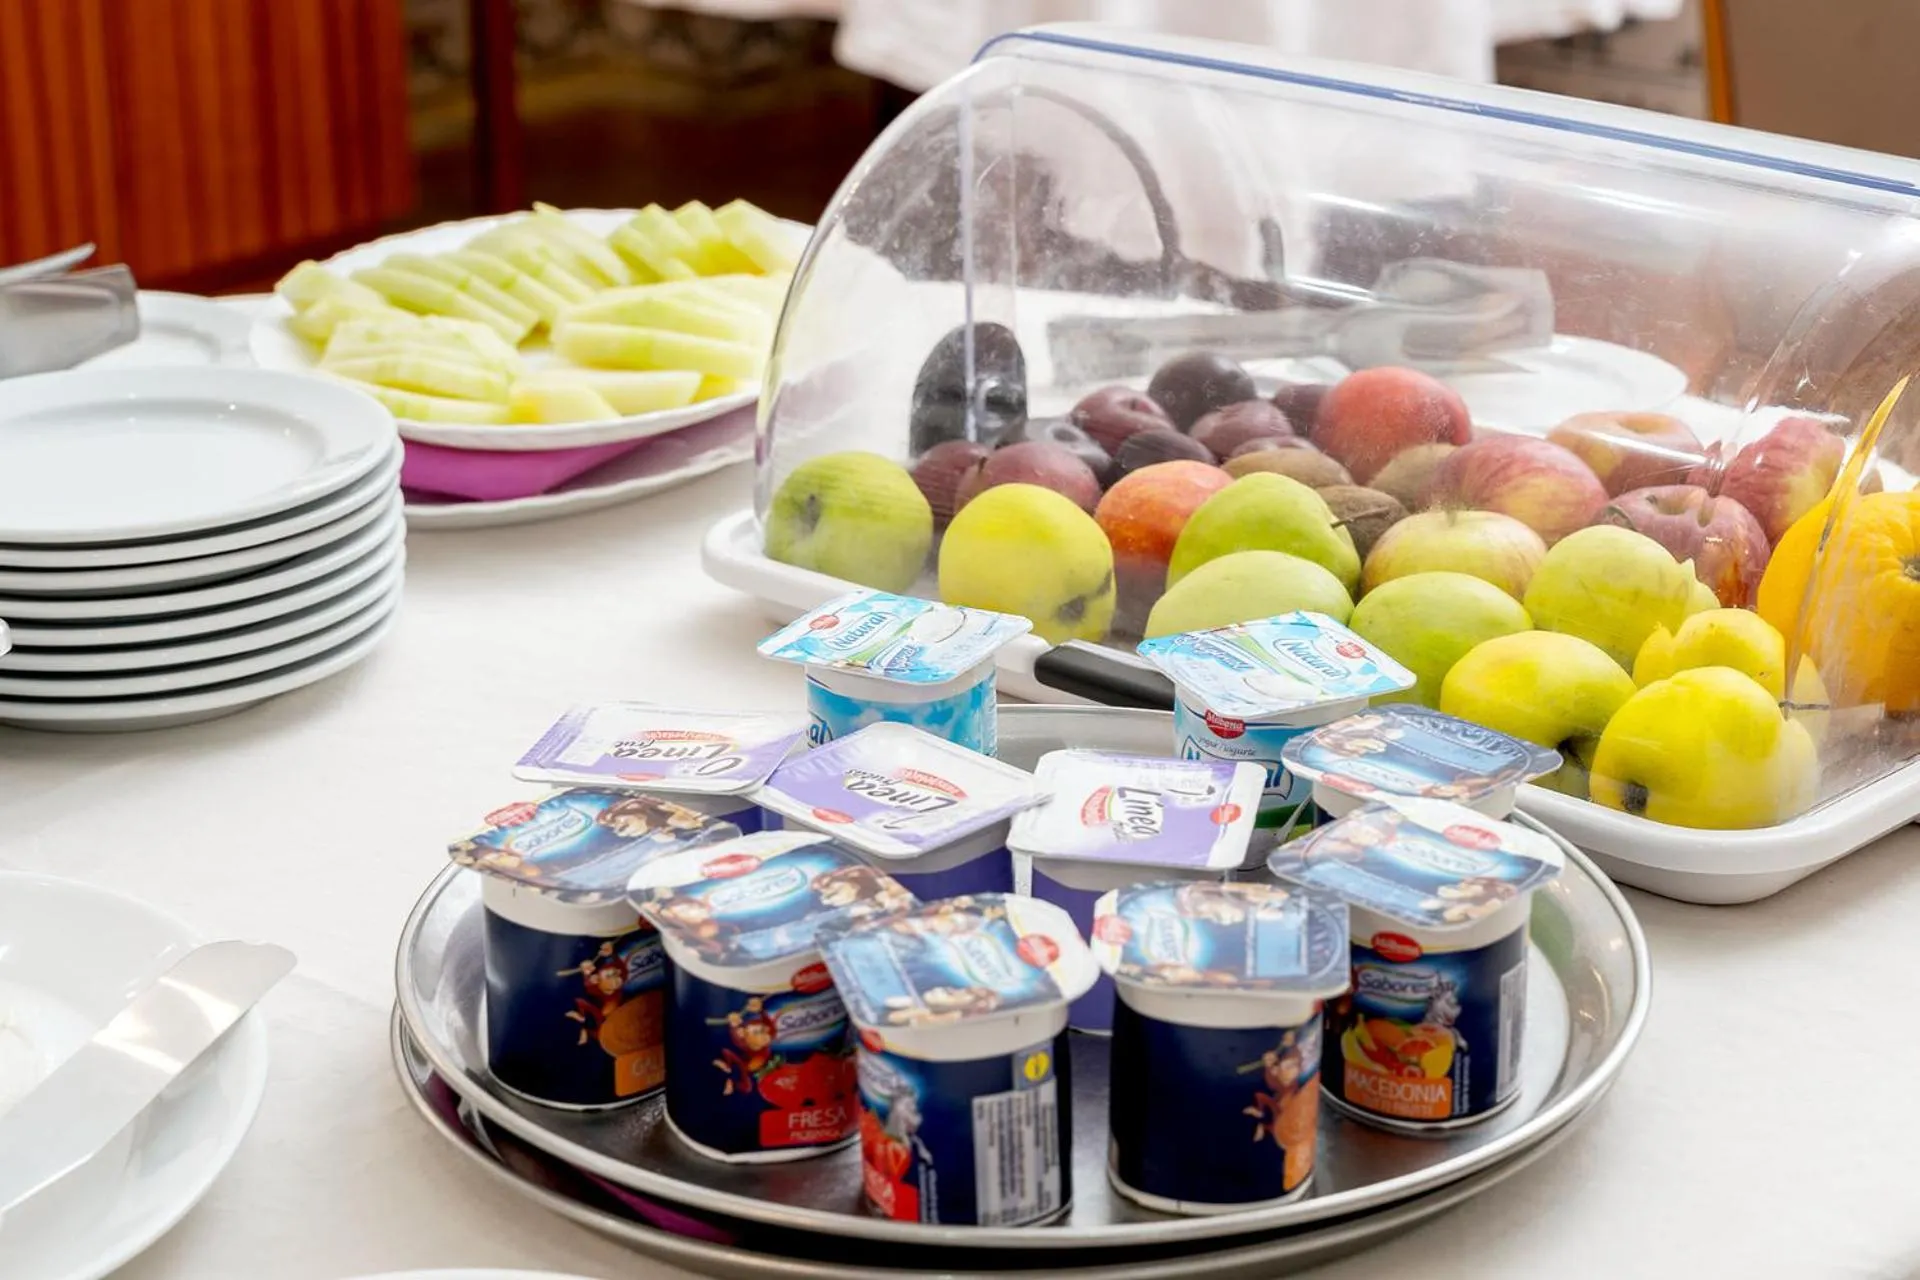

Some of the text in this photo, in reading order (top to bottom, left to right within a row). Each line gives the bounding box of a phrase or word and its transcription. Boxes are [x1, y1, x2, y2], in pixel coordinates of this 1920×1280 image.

[834, 611, 886, 648] Natural
[1283, 639, 1343, 678] Natural
[1346, 1069, 1447, 1103] MACEDONIA
[788, 1106, 848, 1129] FRESA
